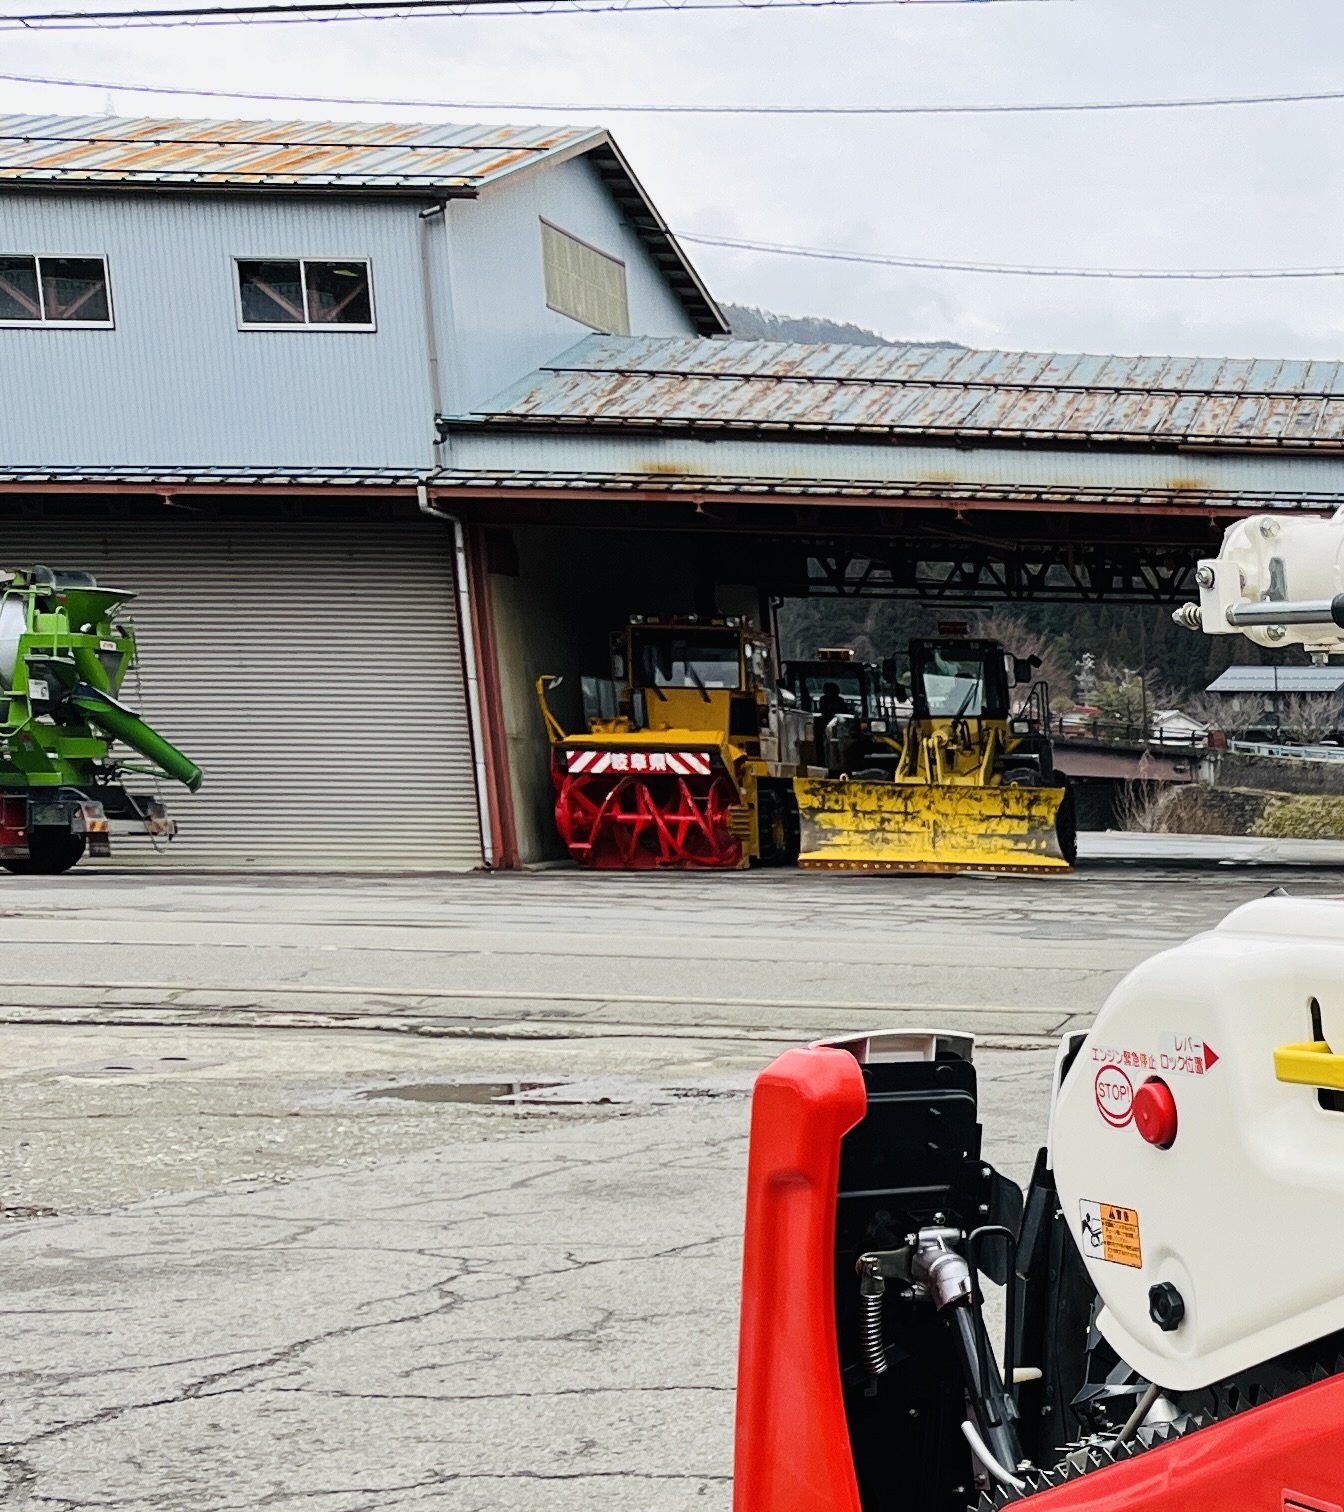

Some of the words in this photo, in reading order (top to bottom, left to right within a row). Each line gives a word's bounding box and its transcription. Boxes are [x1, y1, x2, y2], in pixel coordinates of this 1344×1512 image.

[1174, 1035, 1201, 1052] レバー
[1092, 1047, 1157, 1070] エンジン緊急停止
[1160, 1053, 1204, 1075] ロック位置
[1098, 1082, 1131, 1102] STOP!
